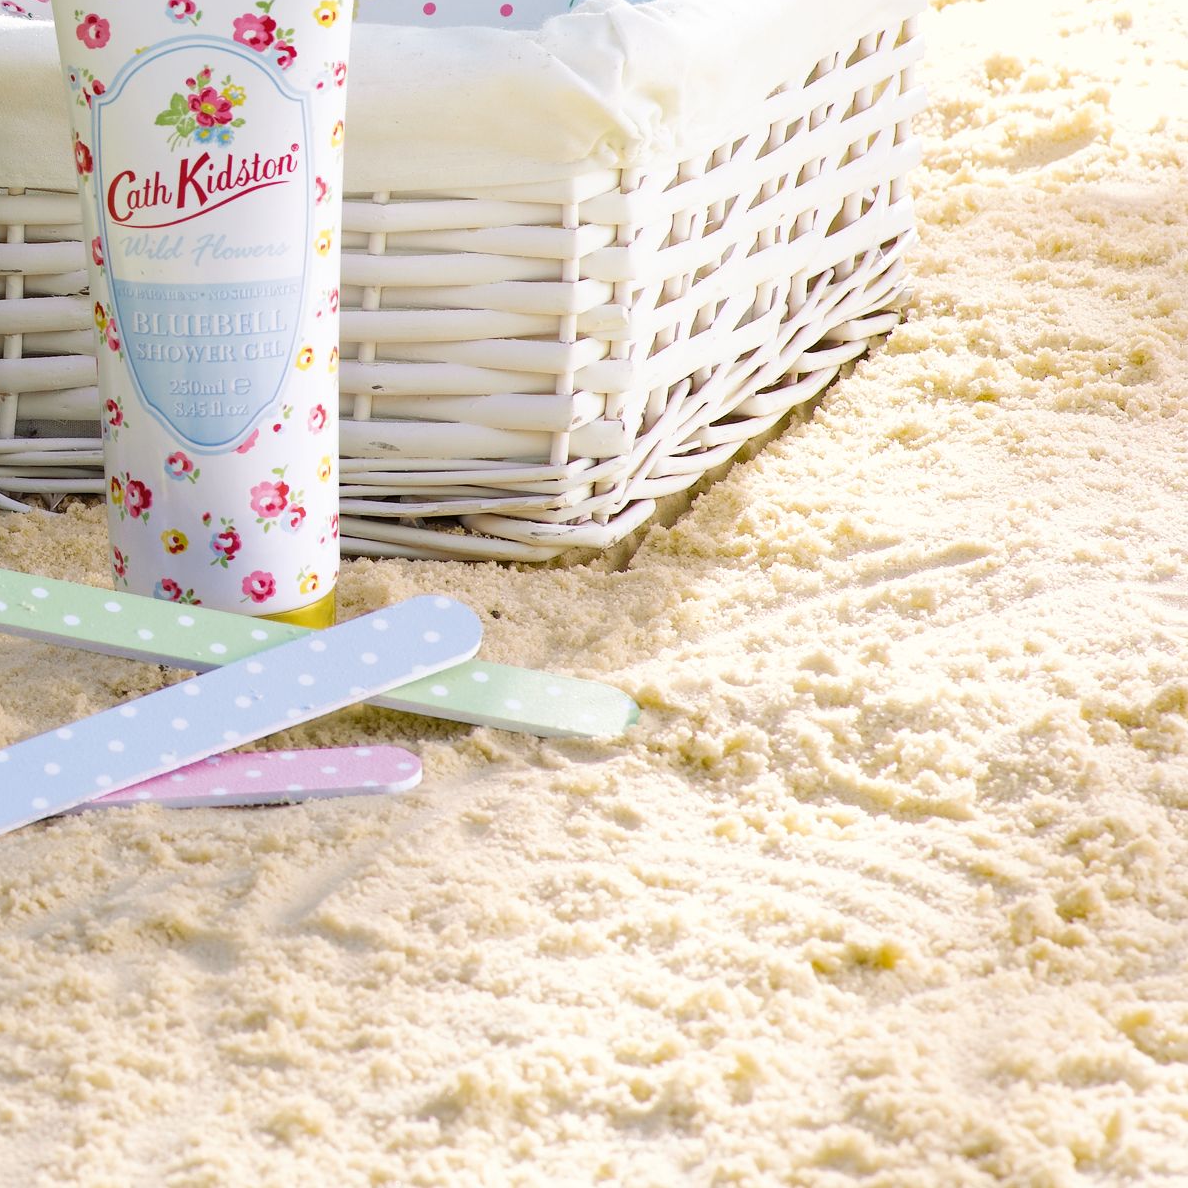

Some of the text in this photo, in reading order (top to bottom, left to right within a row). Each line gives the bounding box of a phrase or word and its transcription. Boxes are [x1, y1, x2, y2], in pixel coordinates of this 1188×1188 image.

[108, 152, 298, 222] Cath Kidston
[120, 233, 292, 266] Wild Flowers
[132, 310, 287, 336] BLUEBELL
[136, 339, 285, 363] SHOWER GEL
[169, 379, 226, 396] 250ml
[173, 402, 248, 417] 8.45 fl oz
